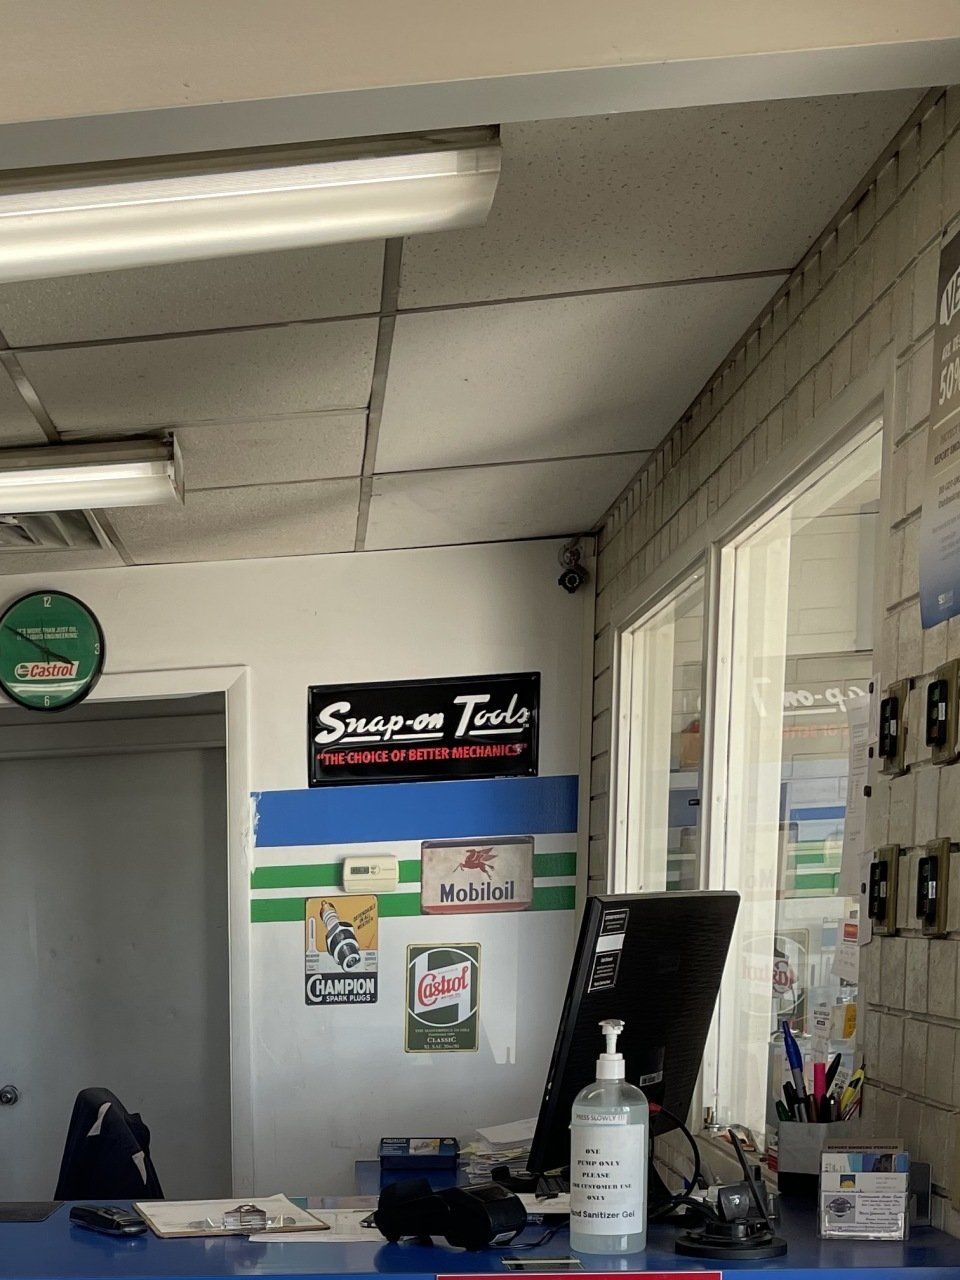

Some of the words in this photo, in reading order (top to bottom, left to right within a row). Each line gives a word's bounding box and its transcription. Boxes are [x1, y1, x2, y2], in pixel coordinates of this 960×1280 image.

[43, 596, 51, 607] 12
[94, 643, 100, 654] 3
[30, 664, 74, 677] Castrol
[44, 695, 50, 706] 6
[315, 701, 444, 744] Snap-on
[453, 693, 530, 738] Tools
[347, 750, 389, 764] CHOICE
[391, 749, 406, 761] OF
[408, 747, 449, 760] BETTER
[441, 881, 515, 903] Mobiloil
[307, 974, 375, 1002] CHAMPION
[418, 966, 468, 1006] Castrol
[350, 994, 371, 1002] PLUGS
[583, 1210, 619, 1219] Sanitizer
